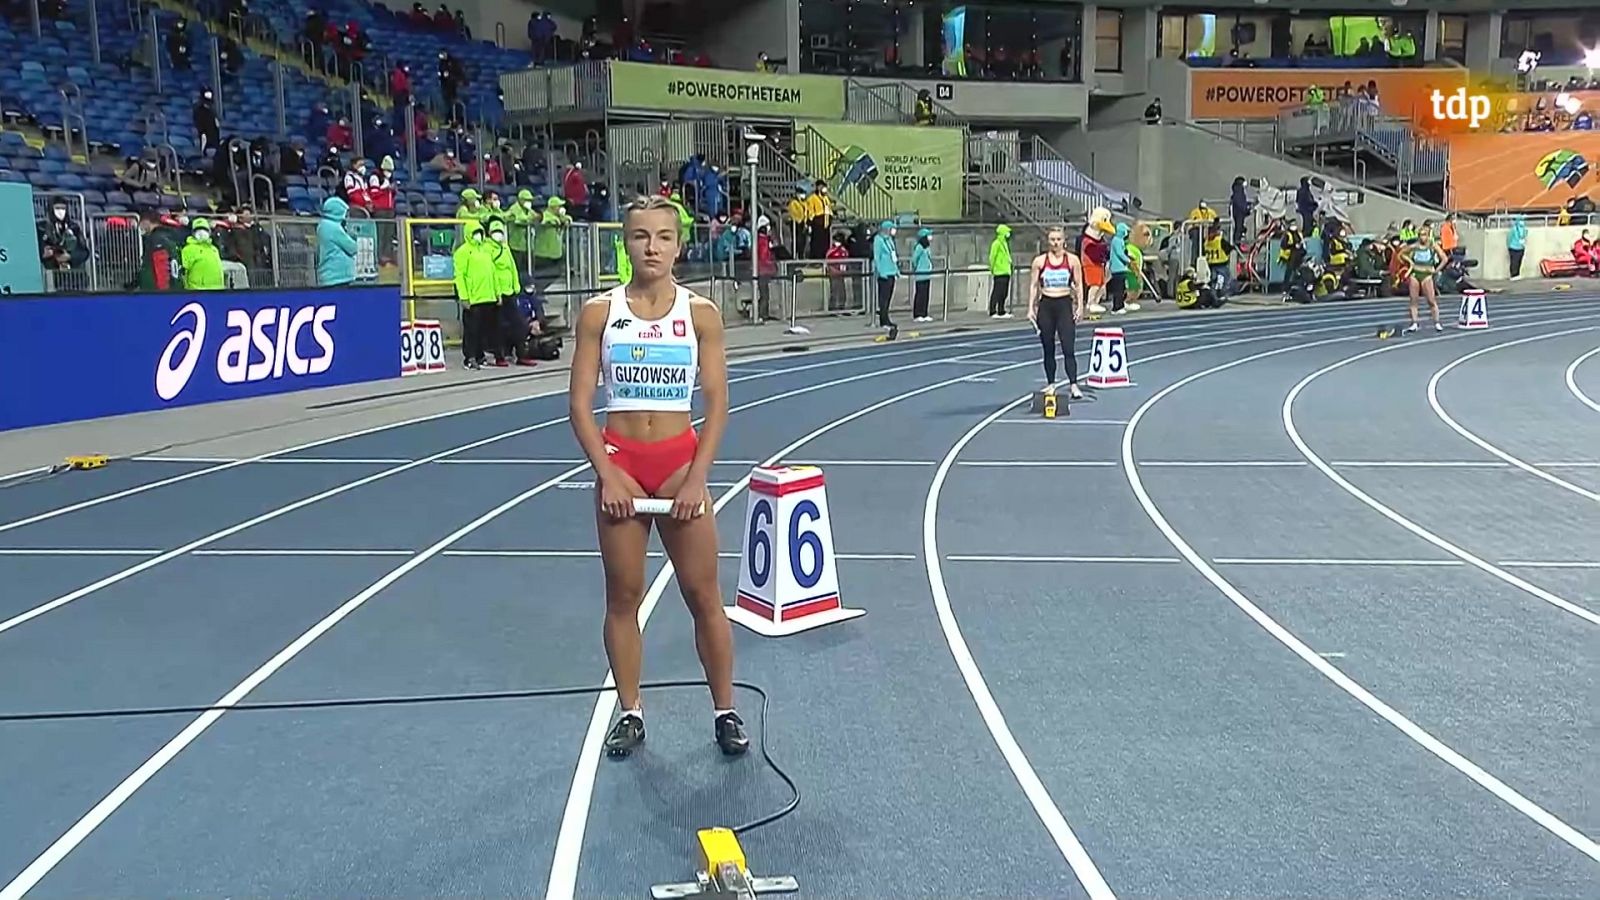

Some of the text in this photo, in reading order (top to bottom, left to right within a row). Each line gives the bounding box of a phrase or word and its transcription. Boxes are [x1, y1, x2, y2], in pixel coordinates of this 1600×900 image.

[668, 81, 801, 104] #POWEROFTHETEAM
[884, 175, 942, 190] SILESIA 21
[615, 365, 687, 384] GUZOWSKA
[635, 386, 673, 398] SILESIA
[749, 499, 773, 589] 6
[788, 499, 824, 589] 6
